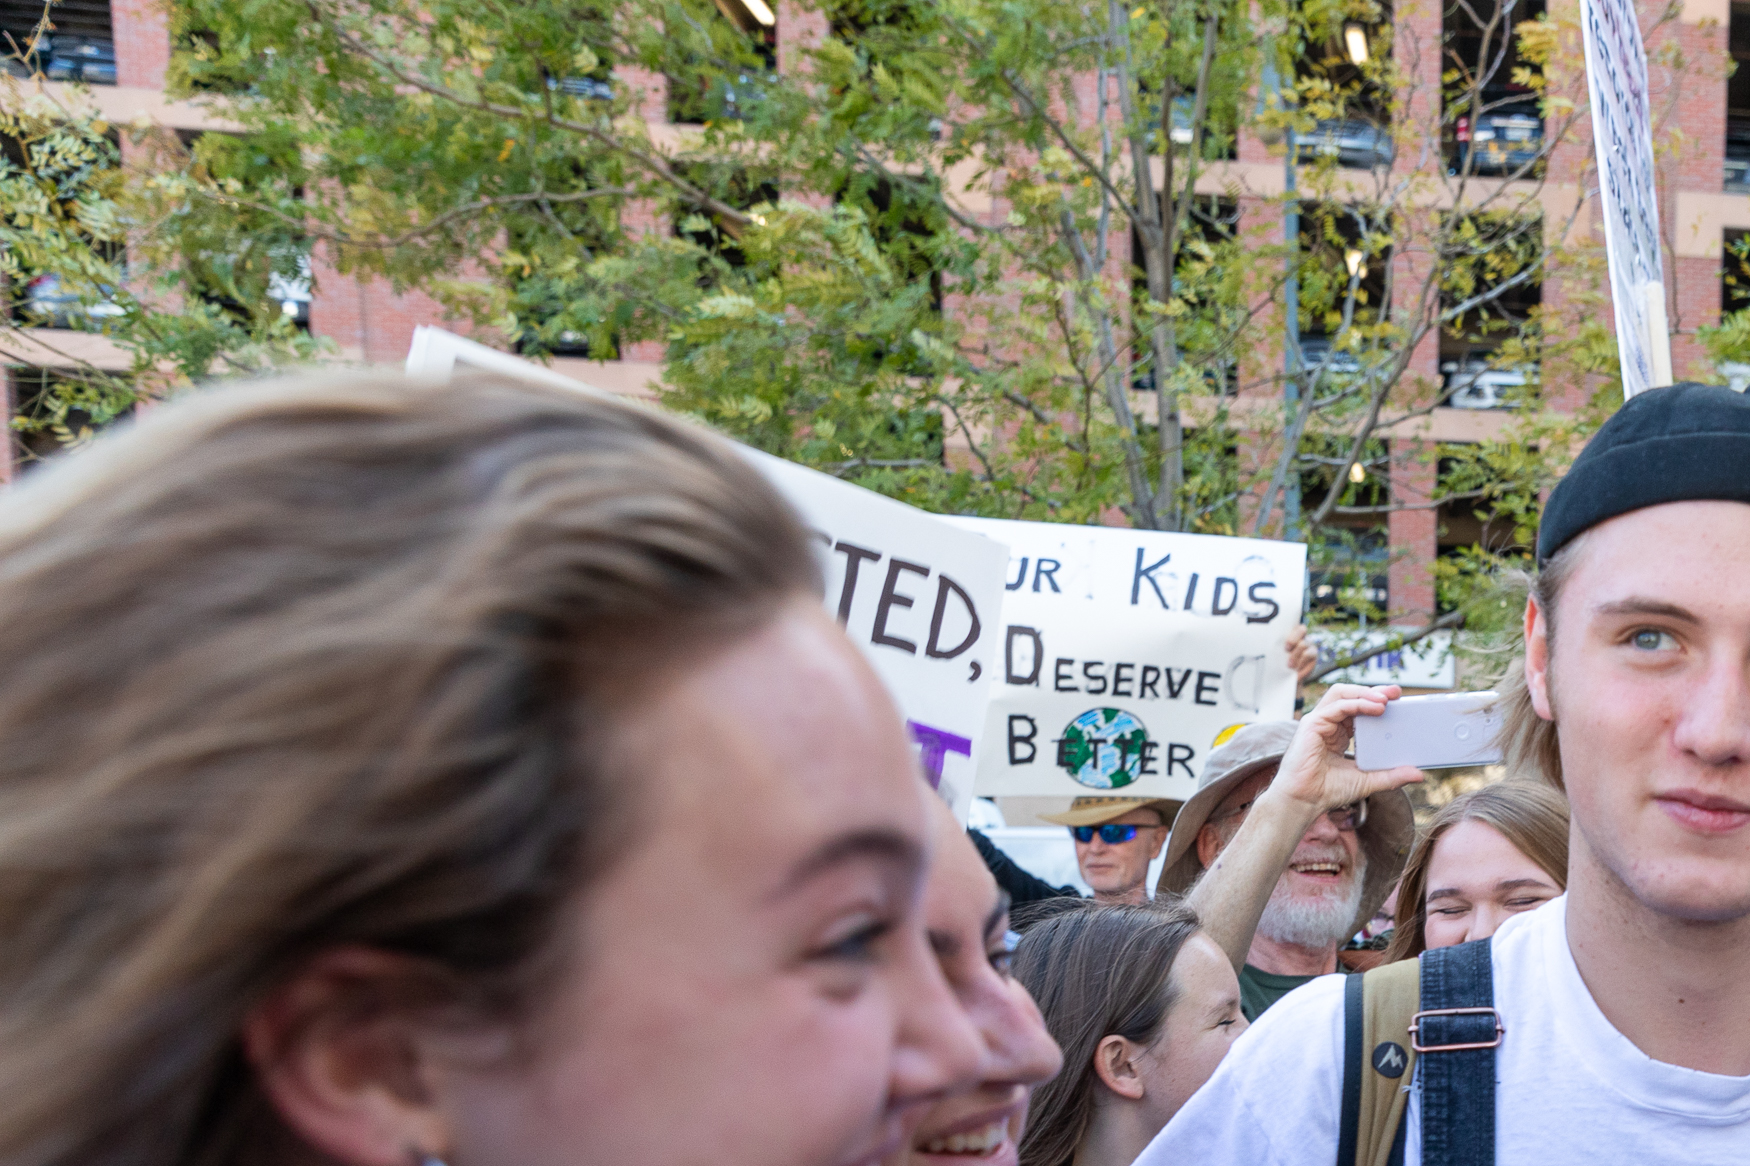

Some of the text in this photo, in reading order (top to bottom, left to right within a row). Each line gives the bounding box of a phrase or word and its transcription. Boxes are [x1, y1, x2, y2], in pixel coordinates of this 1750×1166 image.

[1131, 547, 1279, 624] KIDS
[1005, 625, 1222, 706] DESERVE
[1008, 714, 1195, 779] BETTER
